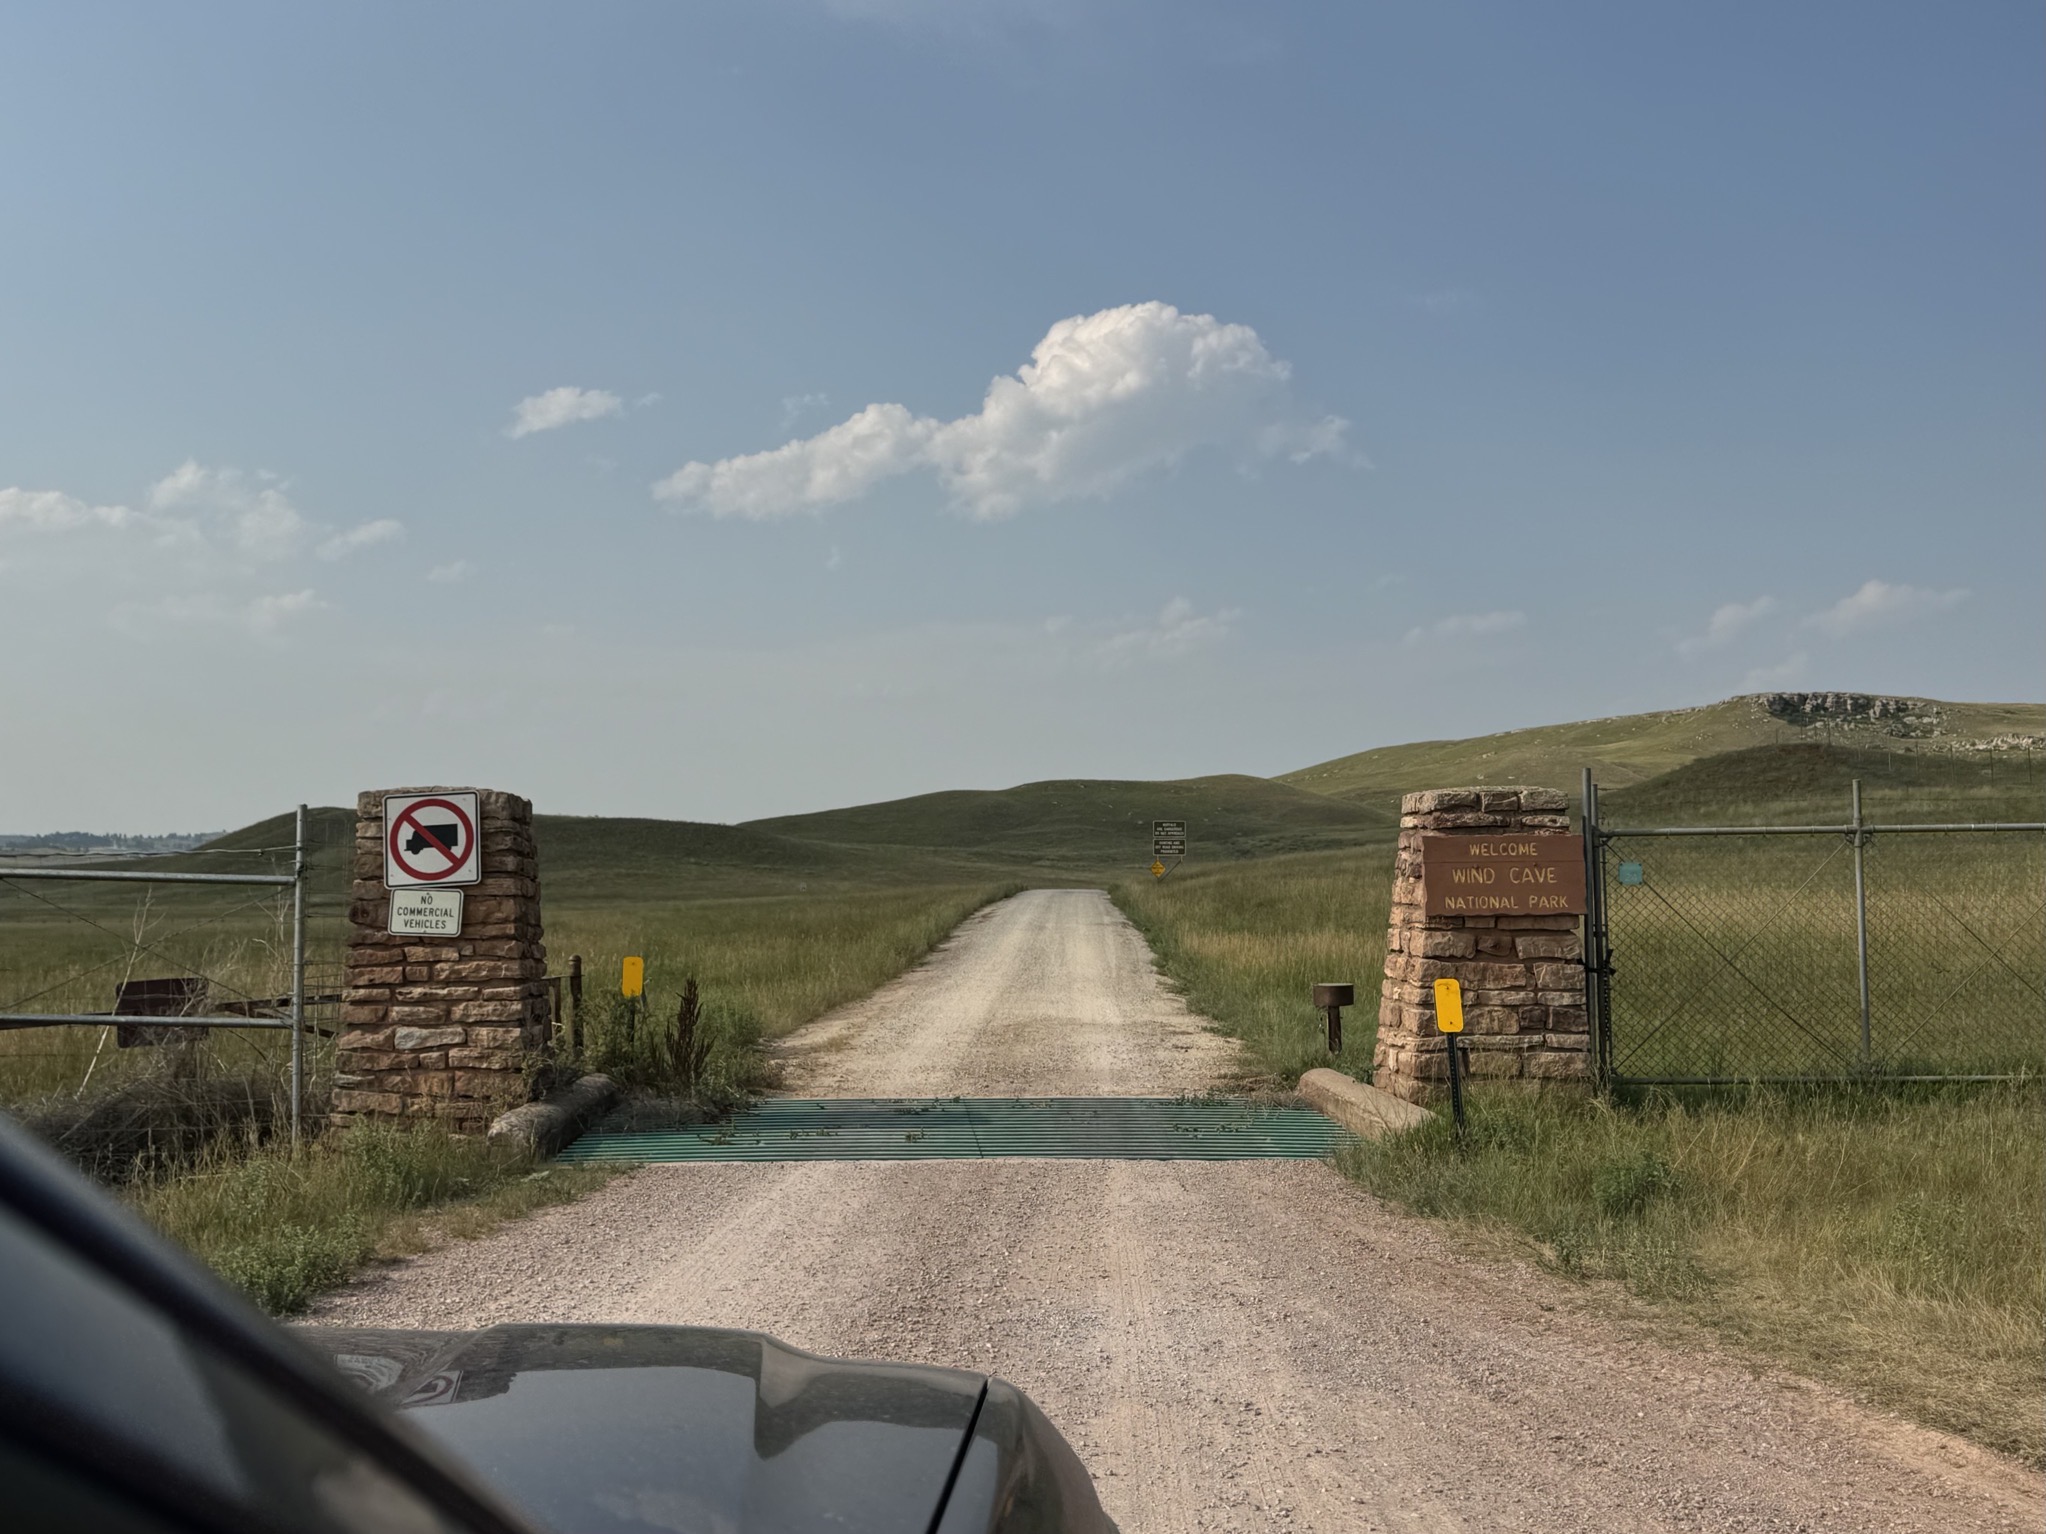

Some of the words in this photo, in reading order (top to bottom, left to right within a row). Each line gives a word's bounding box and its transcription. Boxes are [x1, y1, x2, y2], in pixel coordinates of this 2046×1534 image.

[1469, 843, 1538, 856] WELCOME
[1452, 867, 1495, 884] WIND
[1509, 867, 1558, 884] CAVE
[421, 896, 433, 905] NO
[1445, 896, 1519, 909] NATIONAL
[1529, 895, 1568, 908] PARK
[397, 906, 454, 918] COMMERCIAL
[404, 918, 446, 930] VEHICLES
